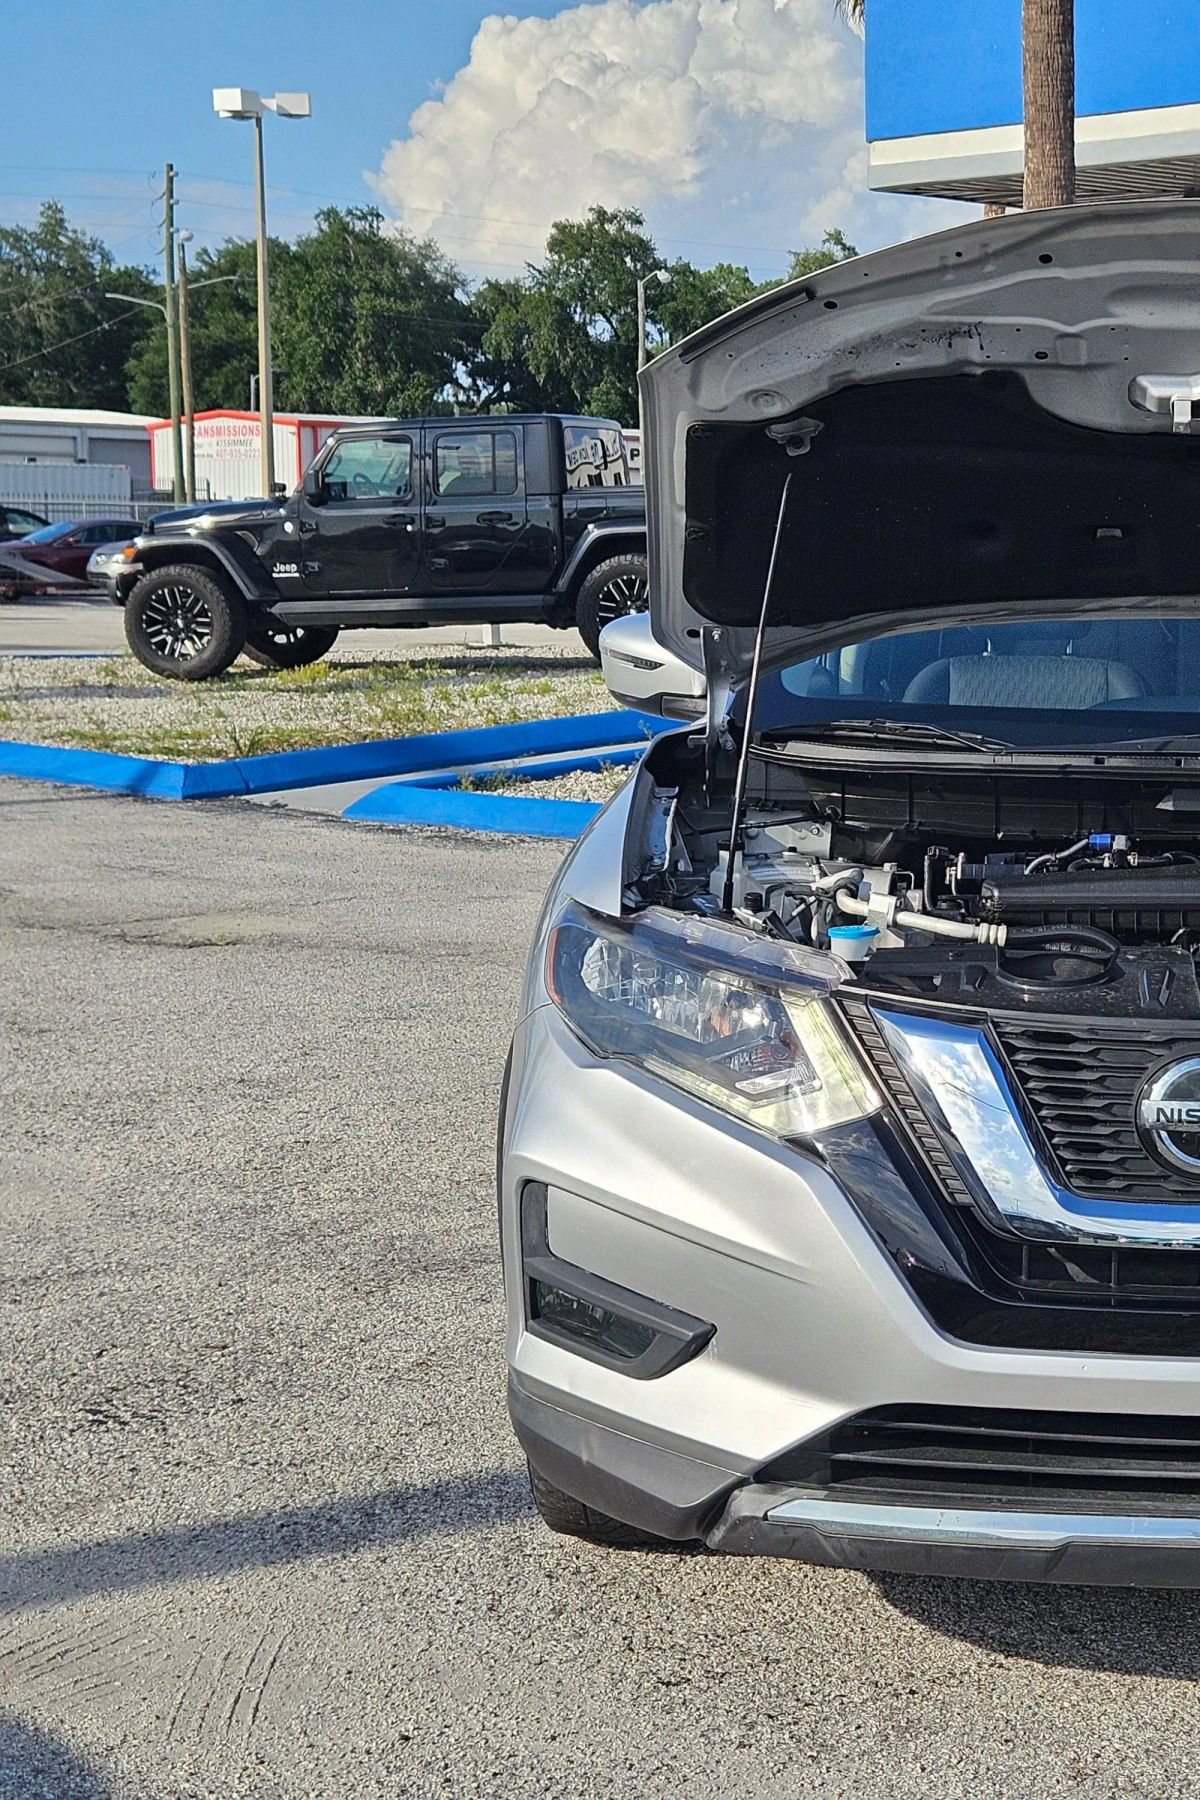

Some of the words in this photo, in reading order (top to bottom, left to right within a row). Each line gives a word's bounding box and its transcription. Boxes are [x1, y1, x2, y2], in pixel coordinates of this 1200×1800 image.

[196, 424, 261, 438] ANSMISSIONS
[216, 439, 253, 448] KISSIMMEE
[273, 562, 298, 573] Jeep
